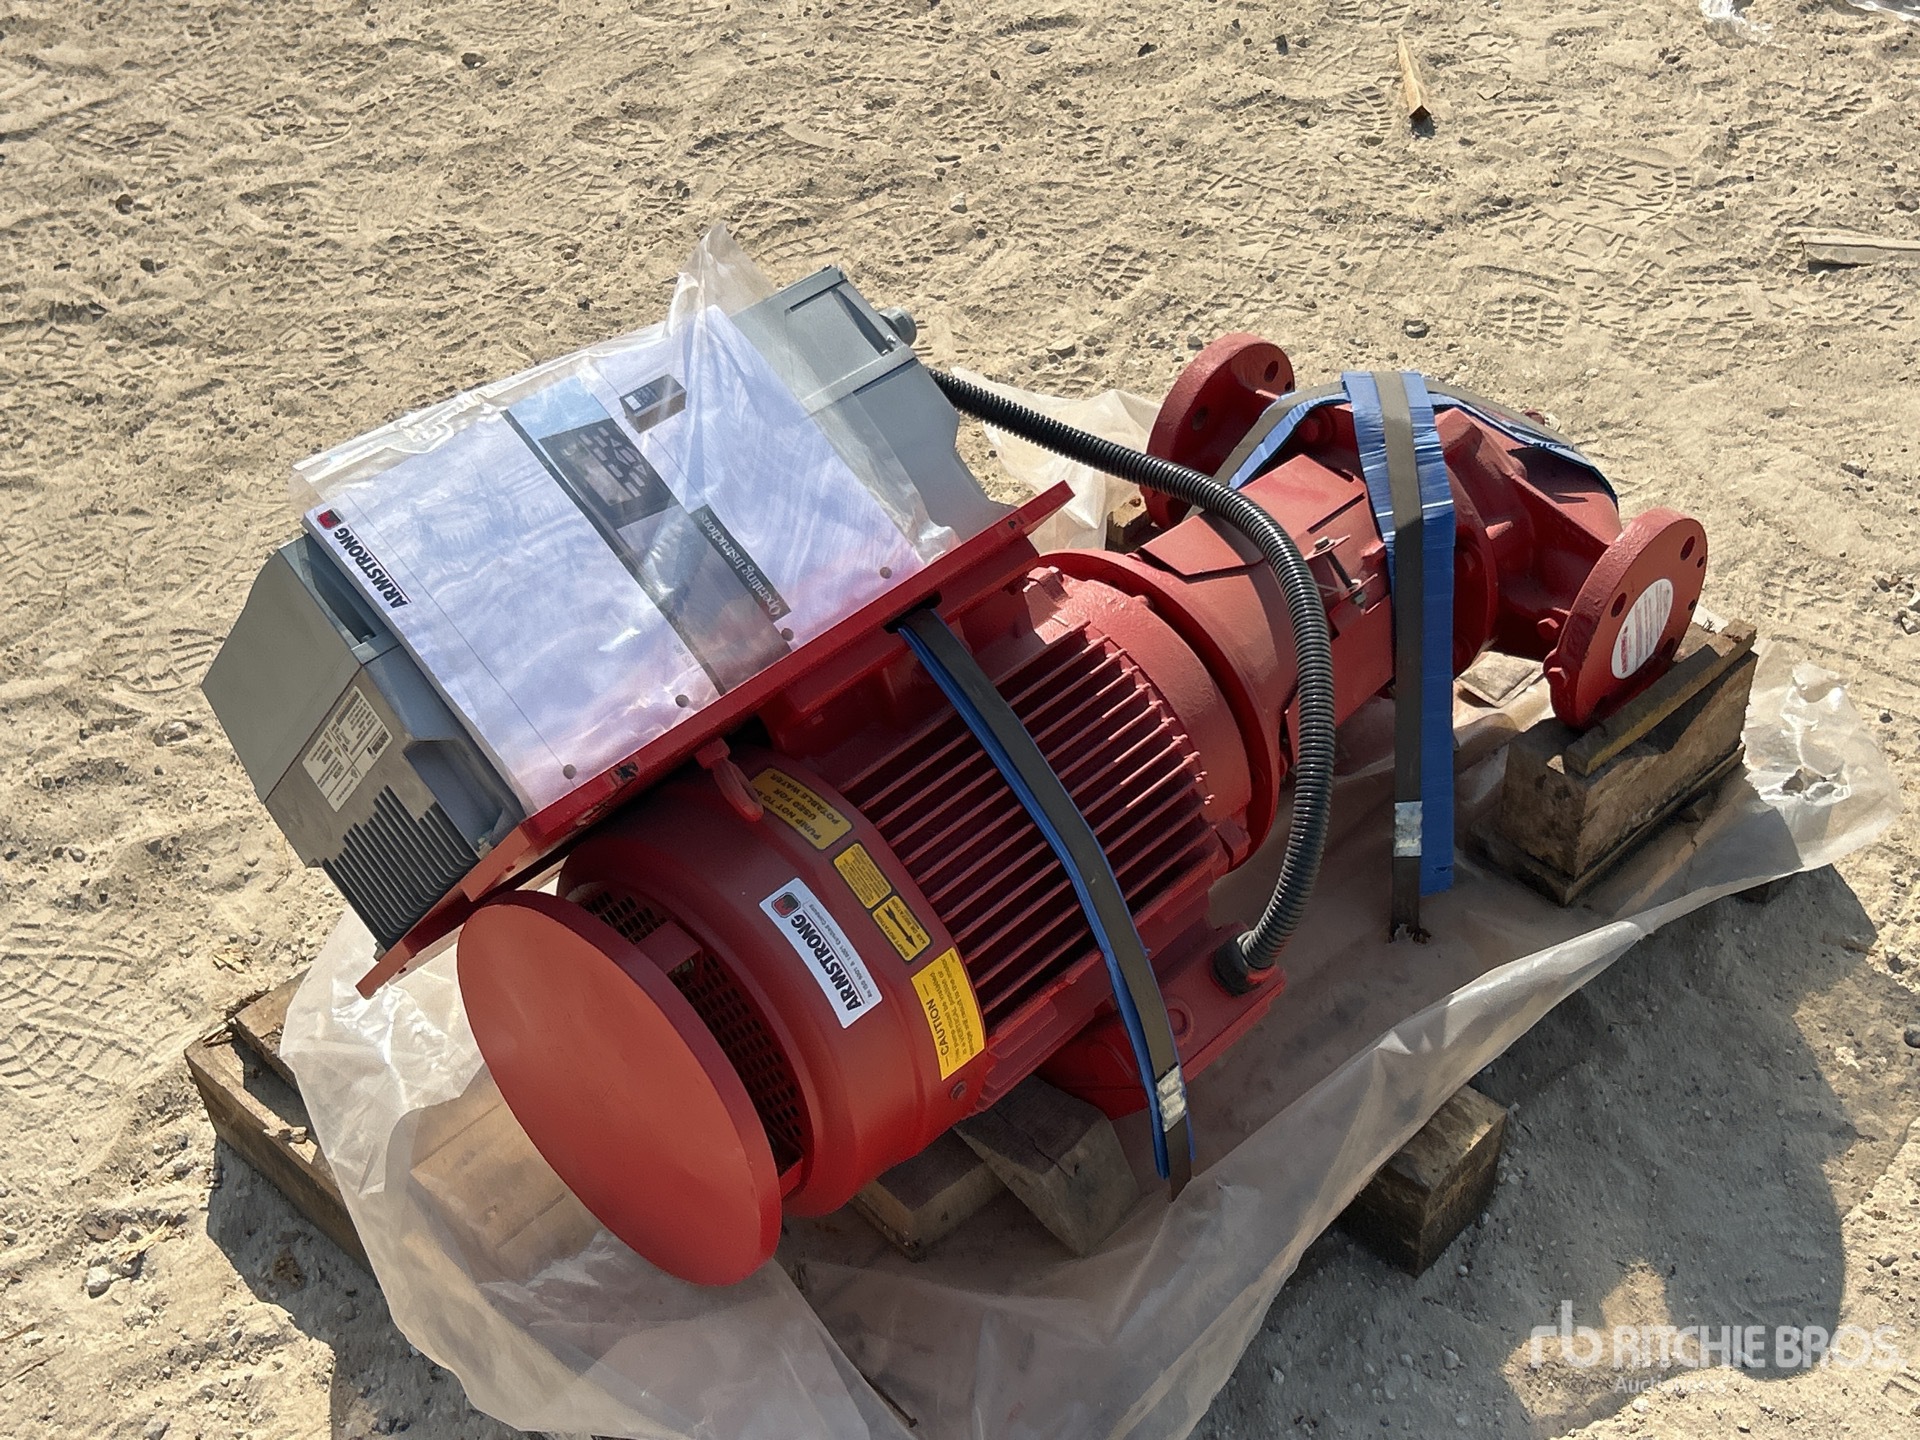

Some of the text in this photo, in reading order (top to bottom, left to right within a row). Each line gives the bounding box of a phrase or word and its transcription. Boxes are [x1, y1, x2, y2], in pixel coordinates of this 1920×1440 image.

[334, 527, 408, 609] ARMSTRONG
[697, 513, 781, 615] Operating Instructions
[762, 794, 777, 806] TO
[770, 773, 840, 824] POTABLE WATER
[773, 788, 817, 821] USED FOR
[776, 803, 796, 819] NOT
[795, 818, 822, 841] PUMP
[791, 914, 860, 1011] ARMSTRONG
[925, 998, 950, 1056] CAUTION
[951, 1007, 965, 1042] VERTICAL
